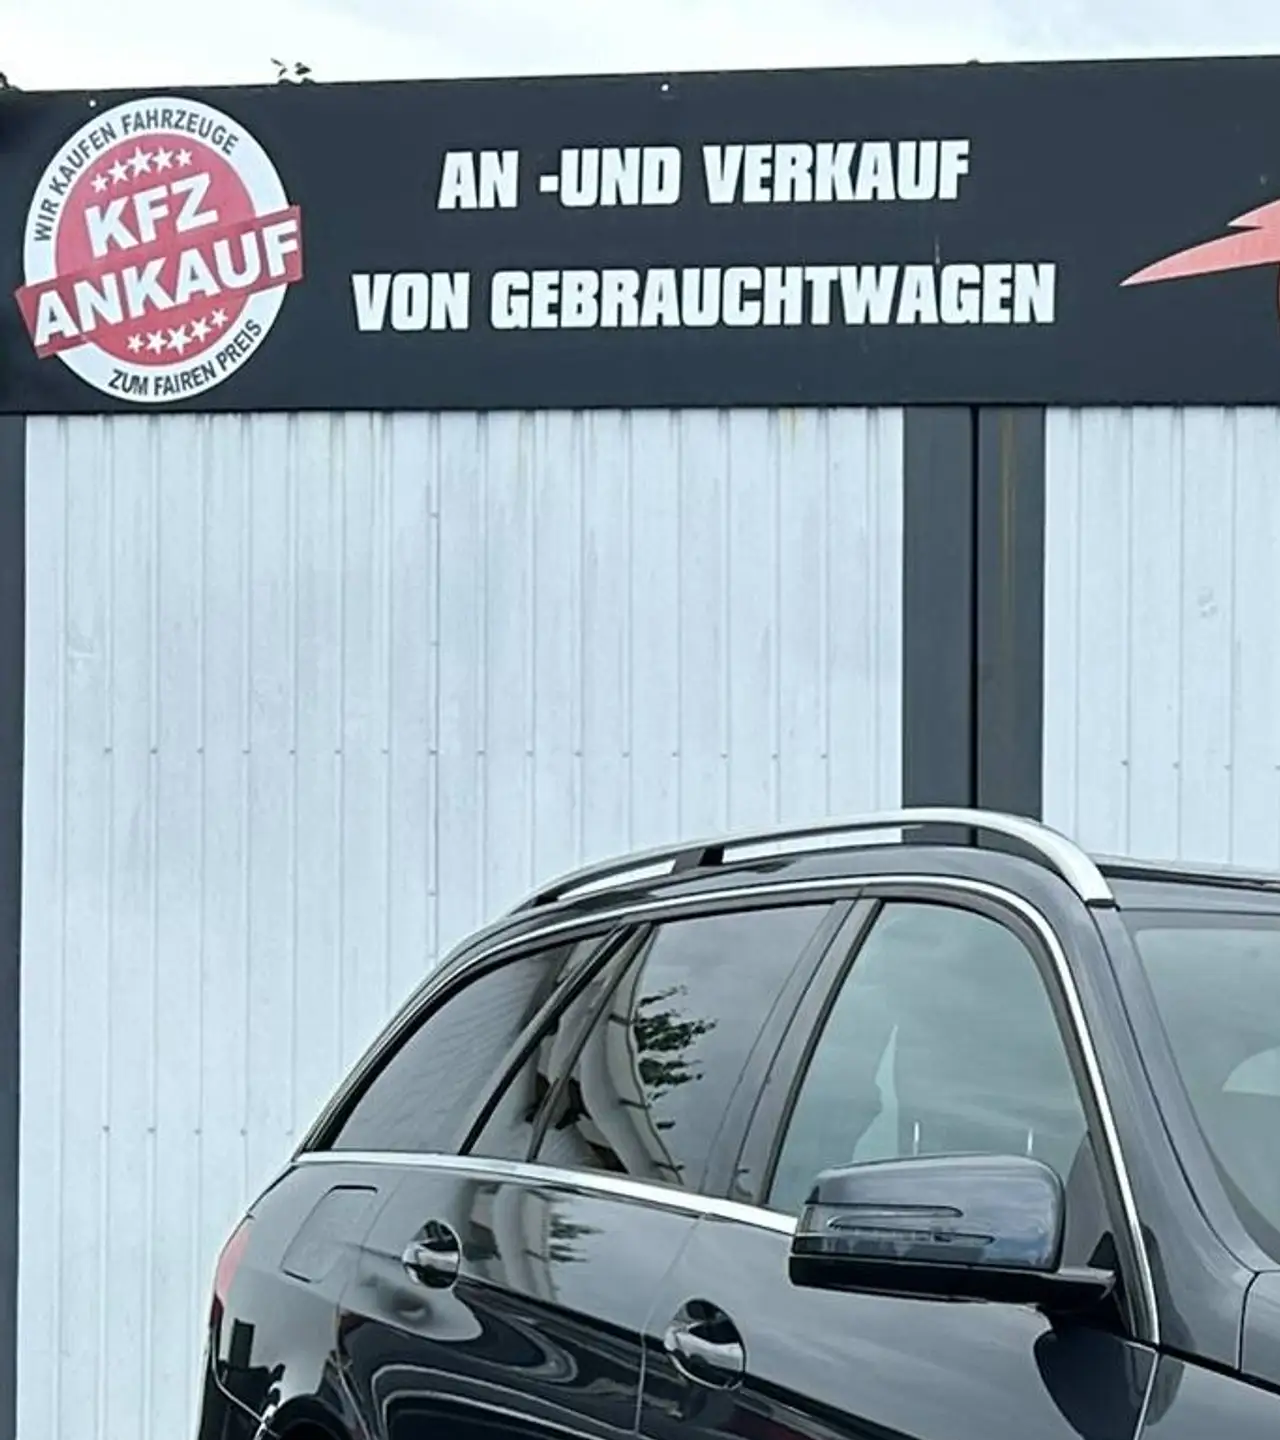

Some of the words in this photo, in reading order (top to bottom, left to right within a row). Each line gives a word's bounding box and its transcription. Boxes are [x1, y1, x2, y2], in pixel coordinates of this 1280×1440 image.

[34, 198, 59, 242] WIR
[49, 121, 118, 195] KAUFEN
[120, 108, 239, 155] FAHRZEUGE
[84, 172, 218, 259] KFZ
[437, 150, 519, 210] AN
[539, 146, 681, 208] -UND
[702, 139, 970, 203] VERKAUF
[34, 219, 299, 347] ANKAUF
[351, 272, 470, 331] VON
[490, 263, 1056, 329] GEBRAUCHTWAGEN
[107, 367, 148, 396] ZUM
[154, 360, 216, 397] FAIREN
[218, 318, 262, 373] PREIS
